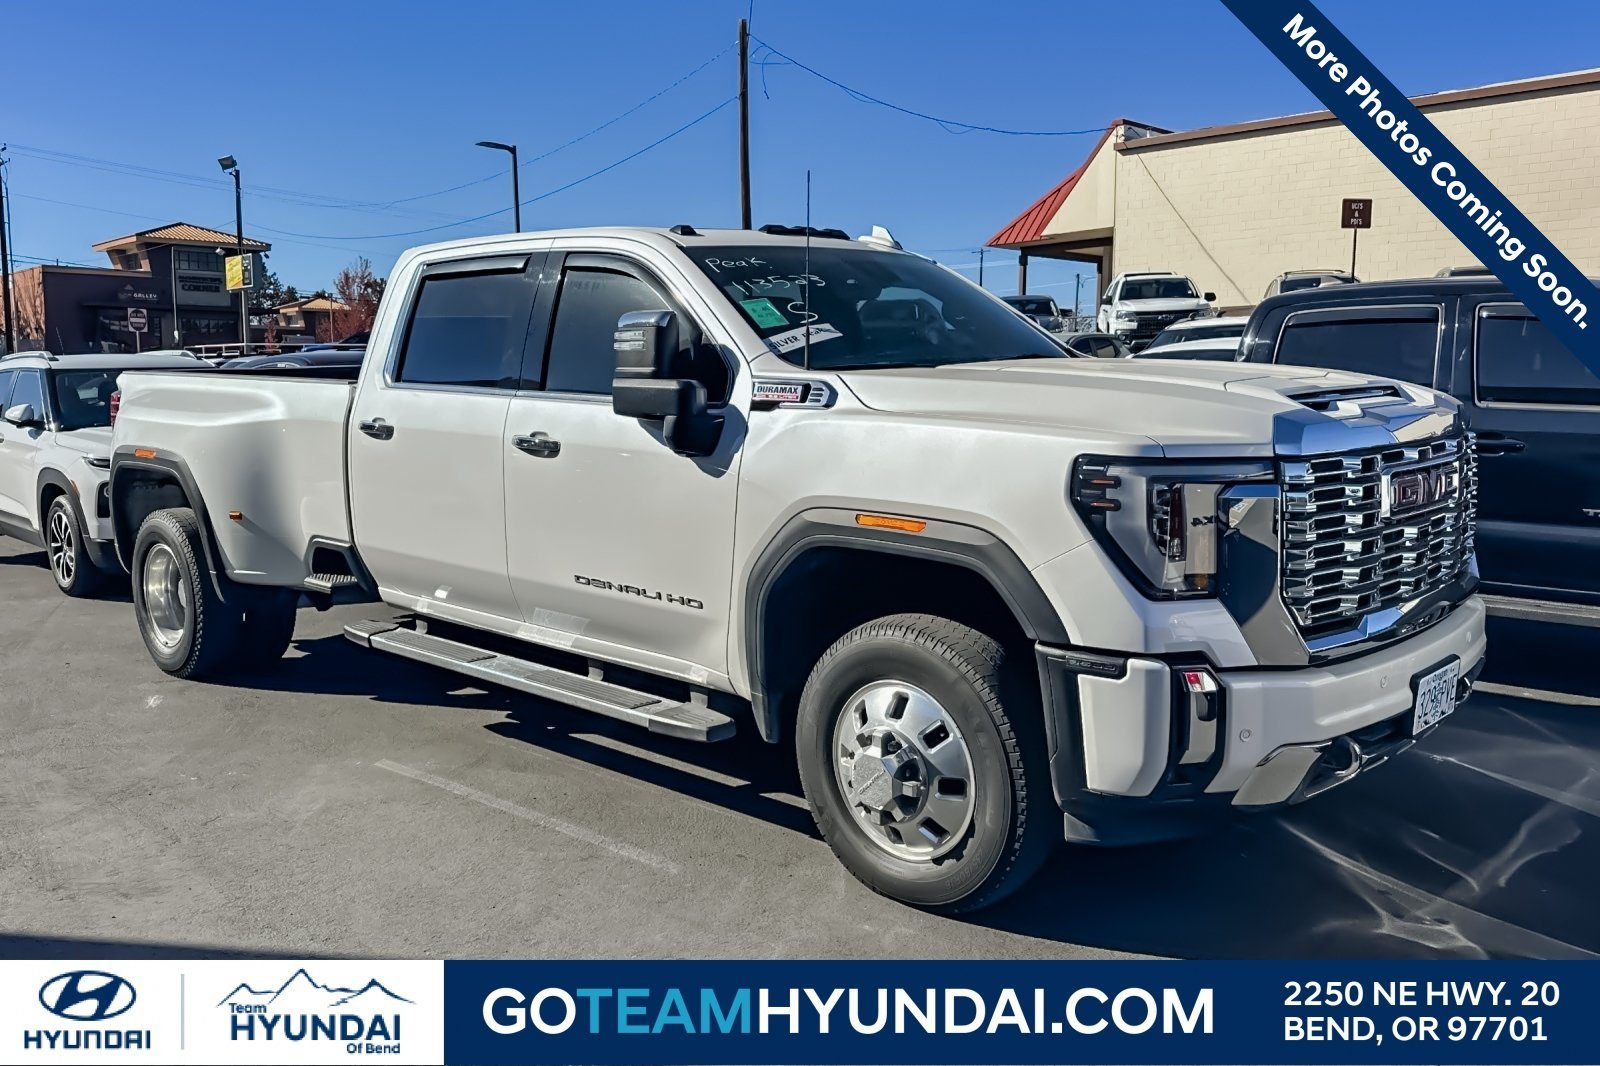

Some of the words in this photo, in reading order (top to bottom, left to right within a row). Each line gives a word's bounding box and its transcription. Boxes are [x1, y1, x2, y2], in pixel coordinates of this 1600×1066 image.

[769, 335, 799, 351] SILVER
[756, 385, 798, 394] DURAMAX
[1393, 467, 1458, 510] GMC
[574, 575, 662, 601] DENALI
[666, 593, 703, 610] HD
